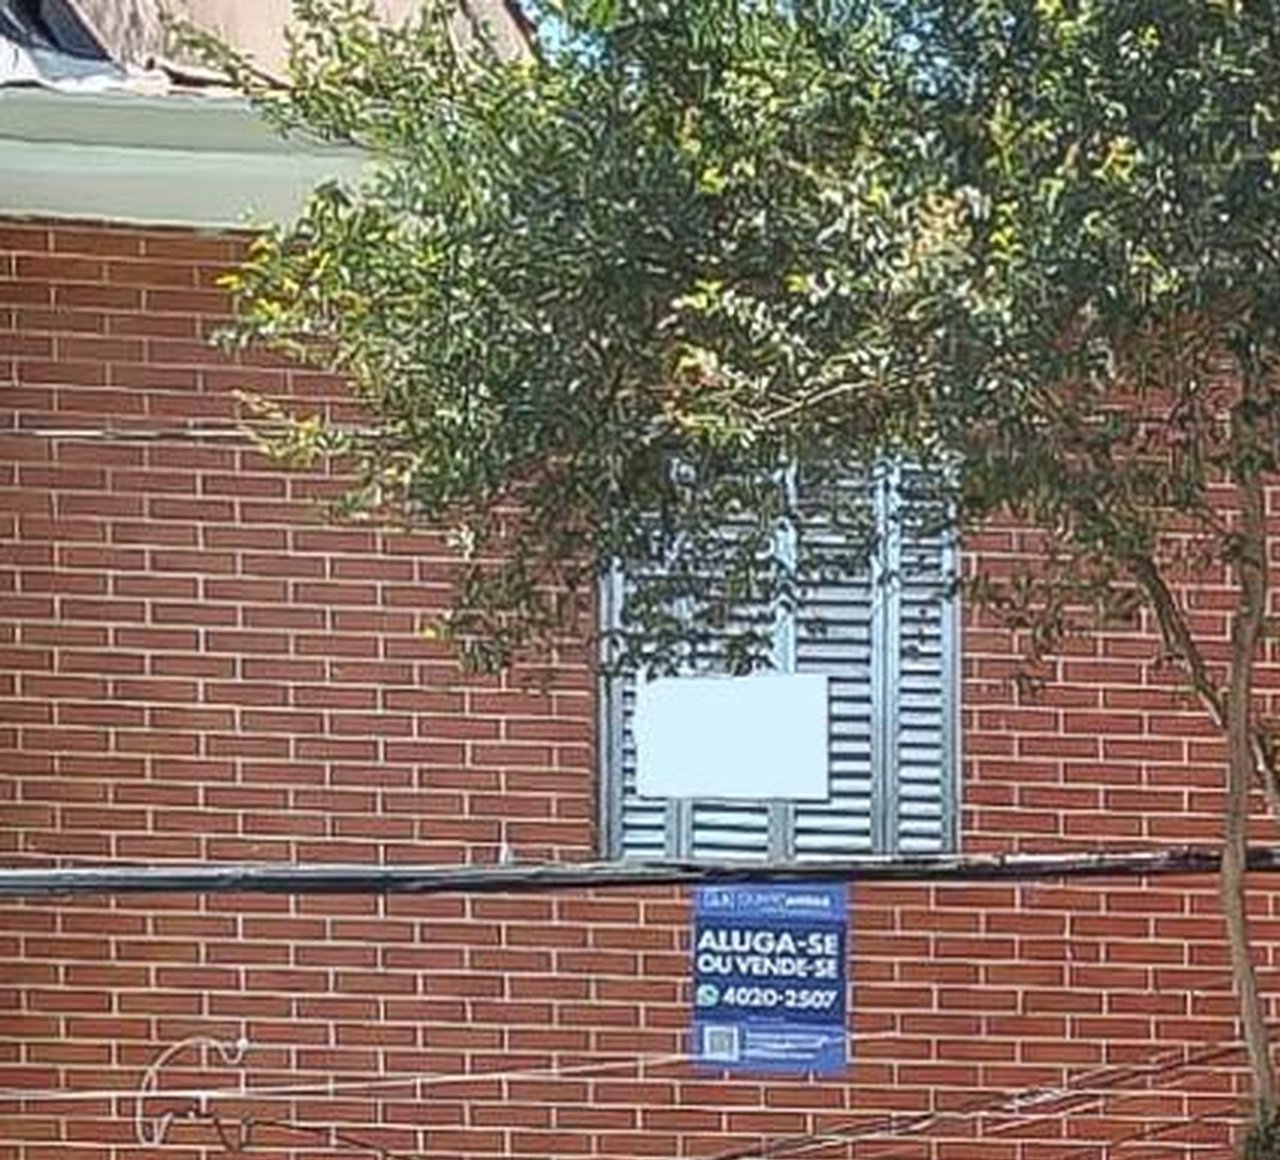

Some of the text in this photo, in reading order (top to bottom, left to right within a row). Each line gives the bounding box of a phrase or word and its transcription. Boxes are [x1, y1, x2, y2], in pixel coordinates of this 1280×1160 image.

[697, 930, 838, 956] ALUGA-SE
[697, 953, 838, 979] OU VENDE-SE
[722, 986, 838, 1009] 4020-2507
